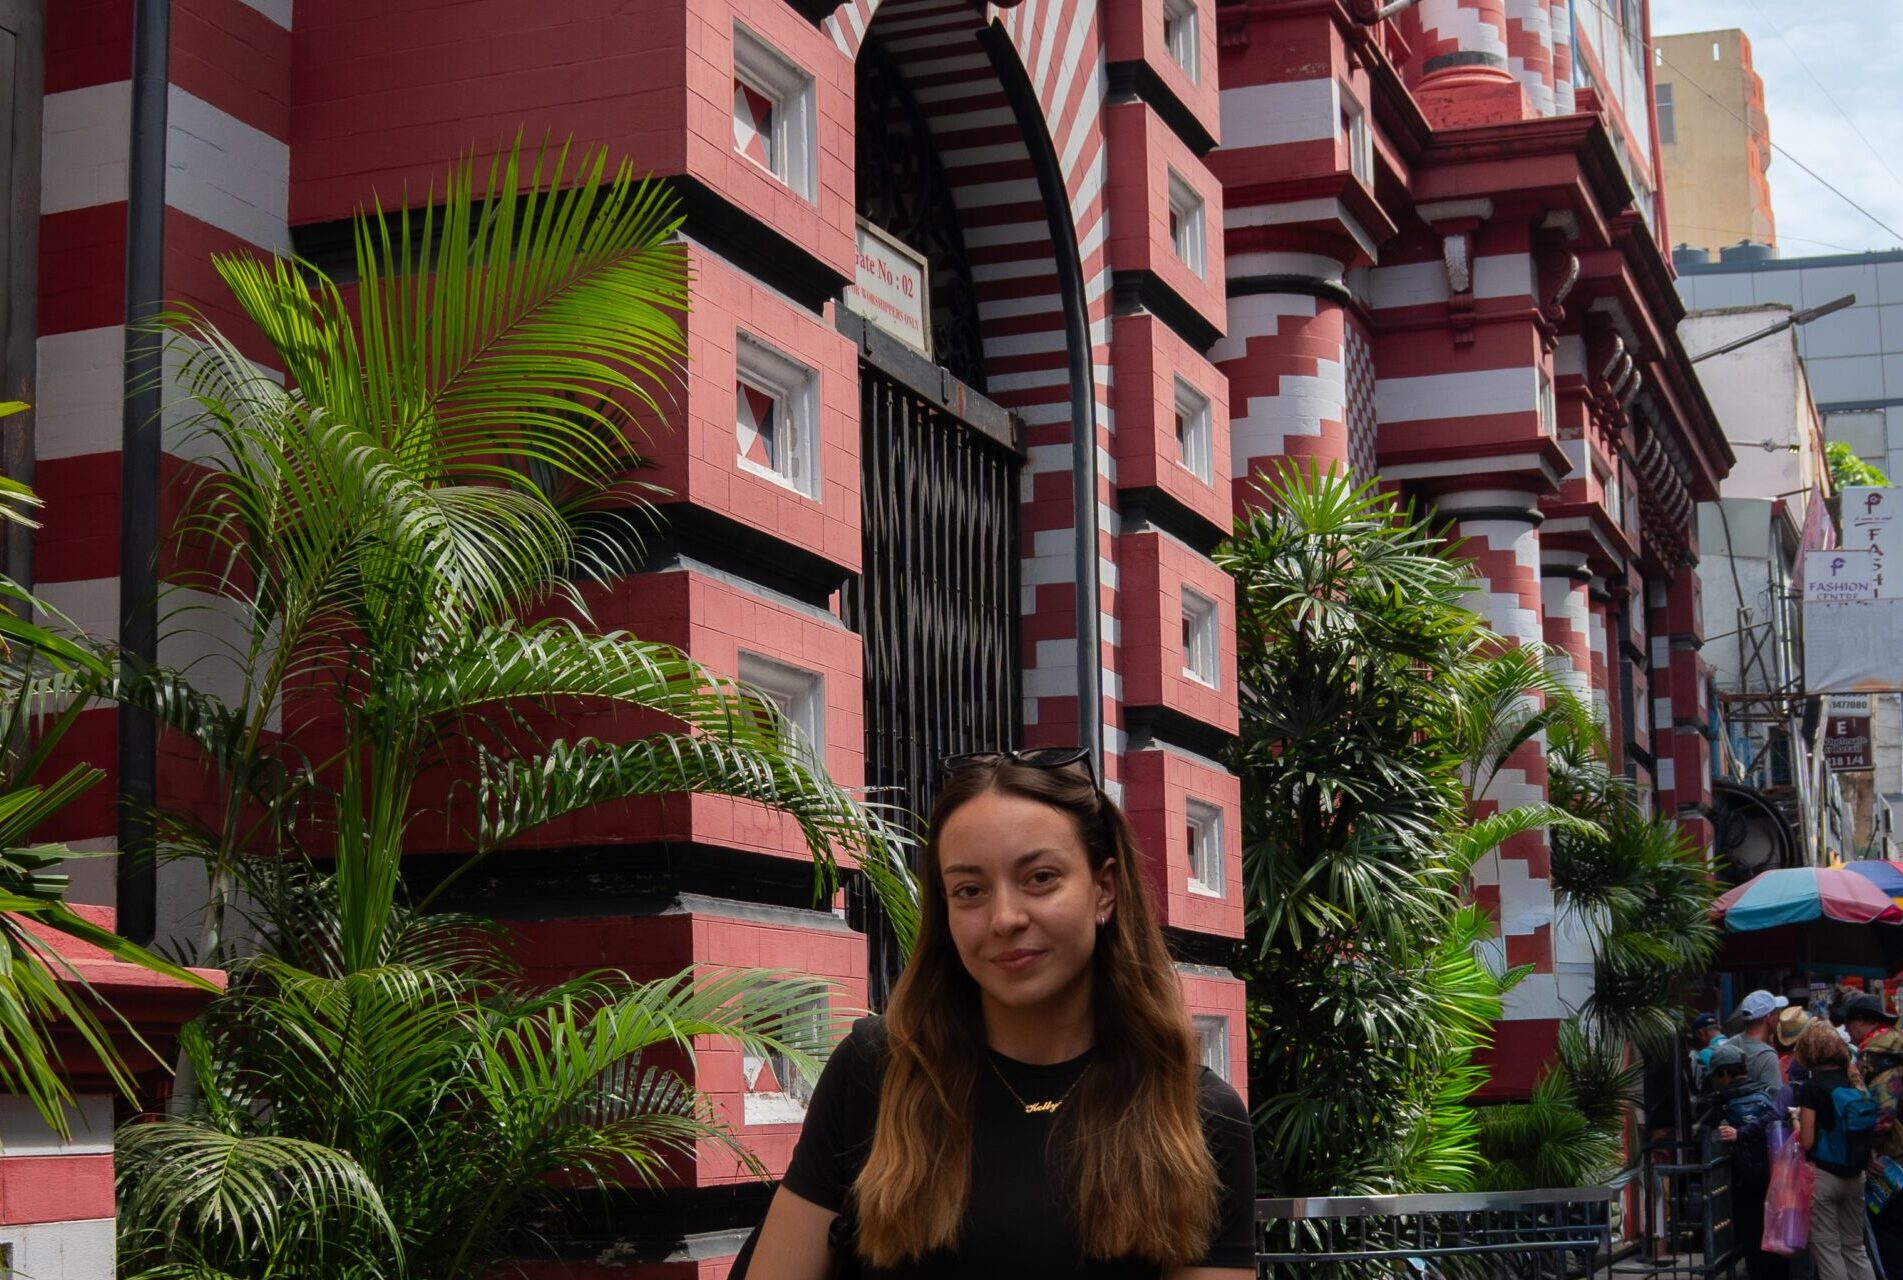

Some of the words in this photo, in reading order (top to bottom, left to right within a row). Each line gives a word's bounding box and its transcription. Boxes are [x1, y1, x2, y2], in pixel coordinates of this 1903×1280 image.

[878, 259, 893, 286] No
[902, 274, 914, 299] 02
[861, 286, 904, 321] WORSHIPPERS
[904, 313, 919, 331] ONLY
[1809, 582, 1869, 592] FASHION
[1816, 592, 1860, 600] CENTRE
